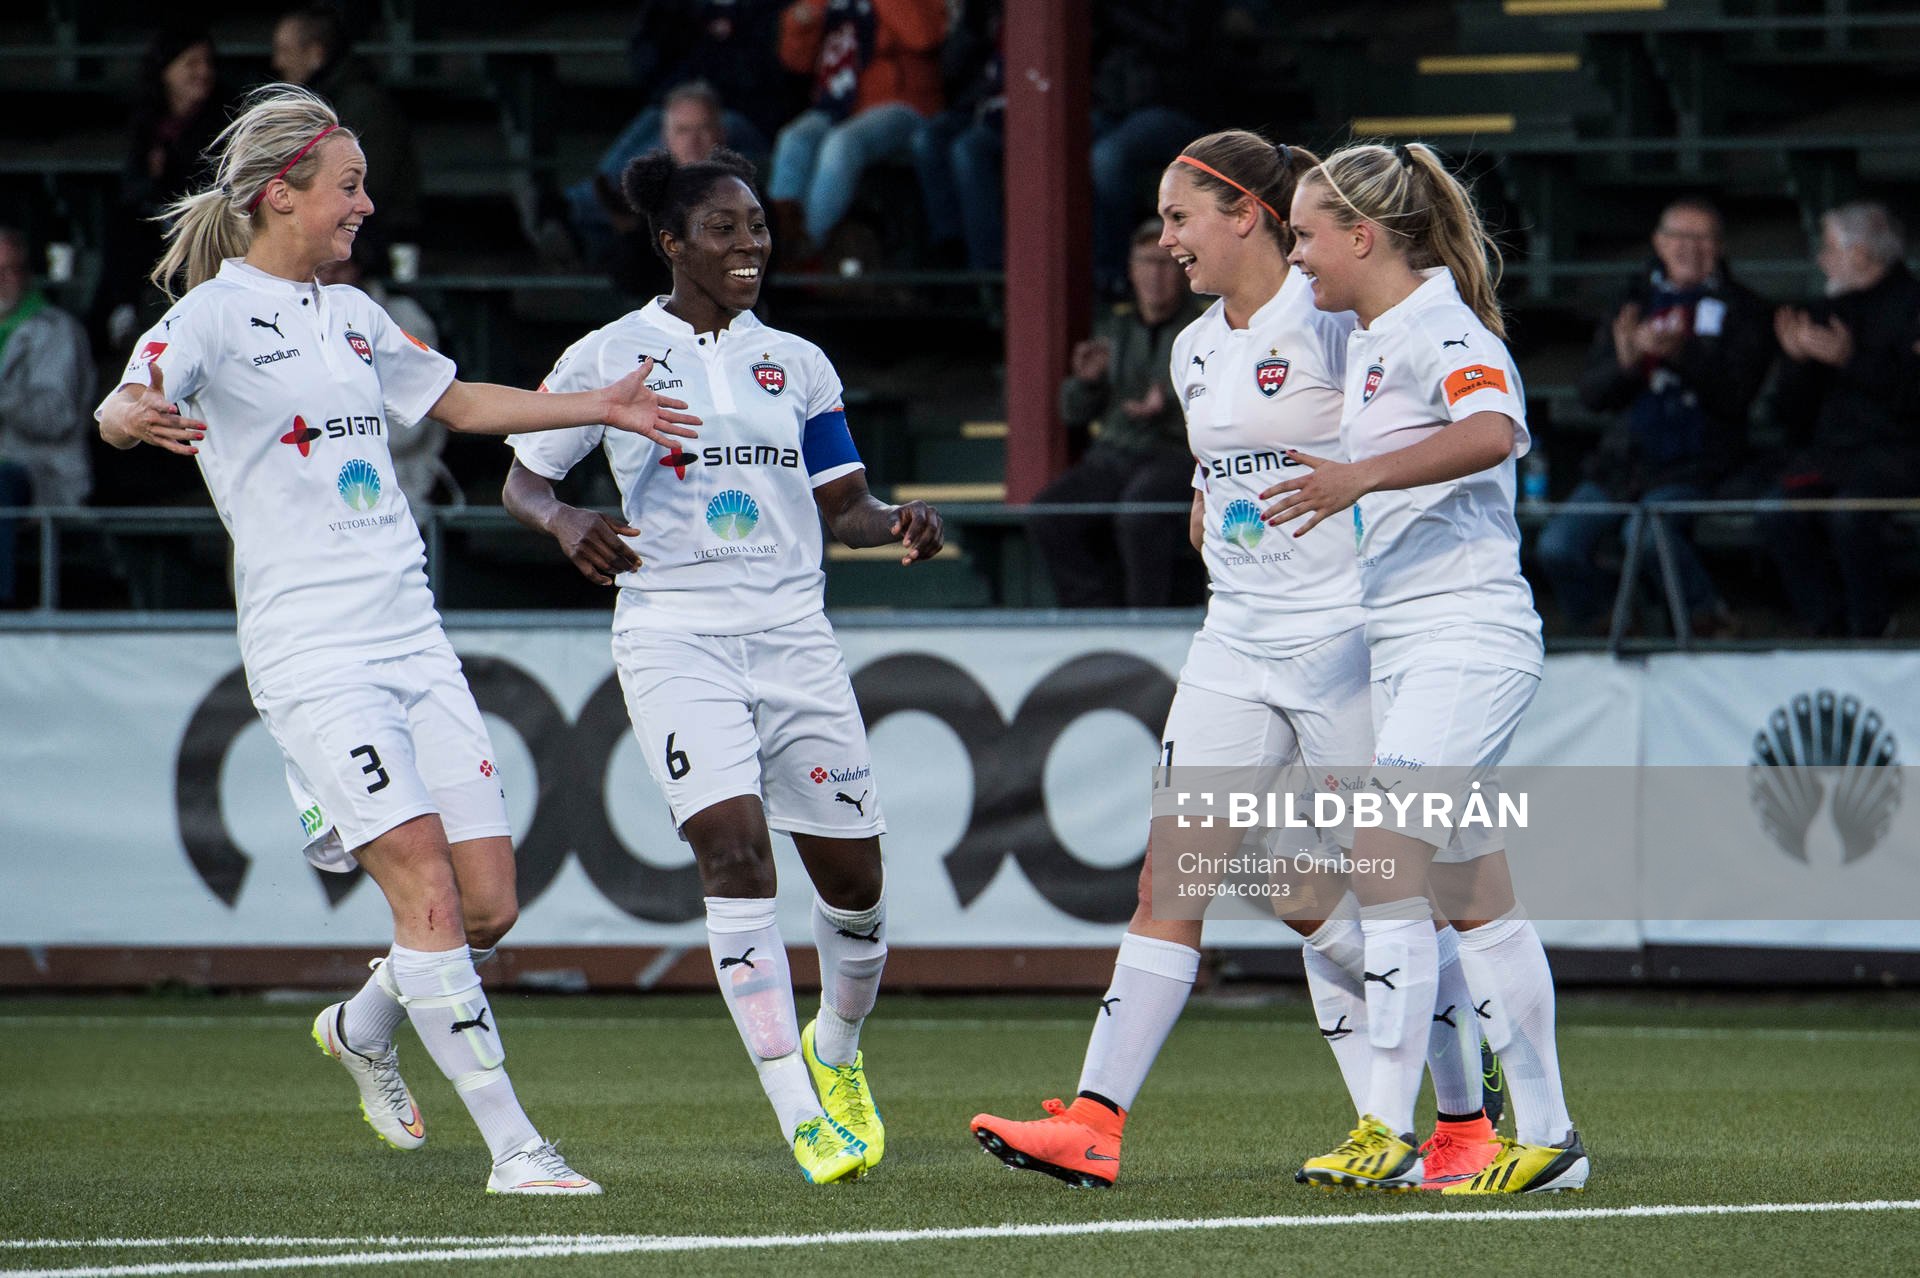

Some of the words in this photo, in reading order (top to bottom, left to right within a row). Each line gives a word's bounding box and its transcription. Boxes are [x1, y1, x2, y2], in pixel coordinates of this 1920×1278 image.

[351, 339, 369, 350] FCR
[253, 348, 301, 366] stadium
[758, 371, 783, 381] FCR
[1259, 367, 1285, 379] FCR
[325, 416, 381, 439] SIGM
[328, 518, 377, 532] VICTORIA
[694, 546, 749, 559] VICTORIA
[750, 545, 777, 554] PARK
[1262, 551, 1291, 564] PARK
[666, 732, 691, 780] 6
[350, 744, 390, 794] 3
